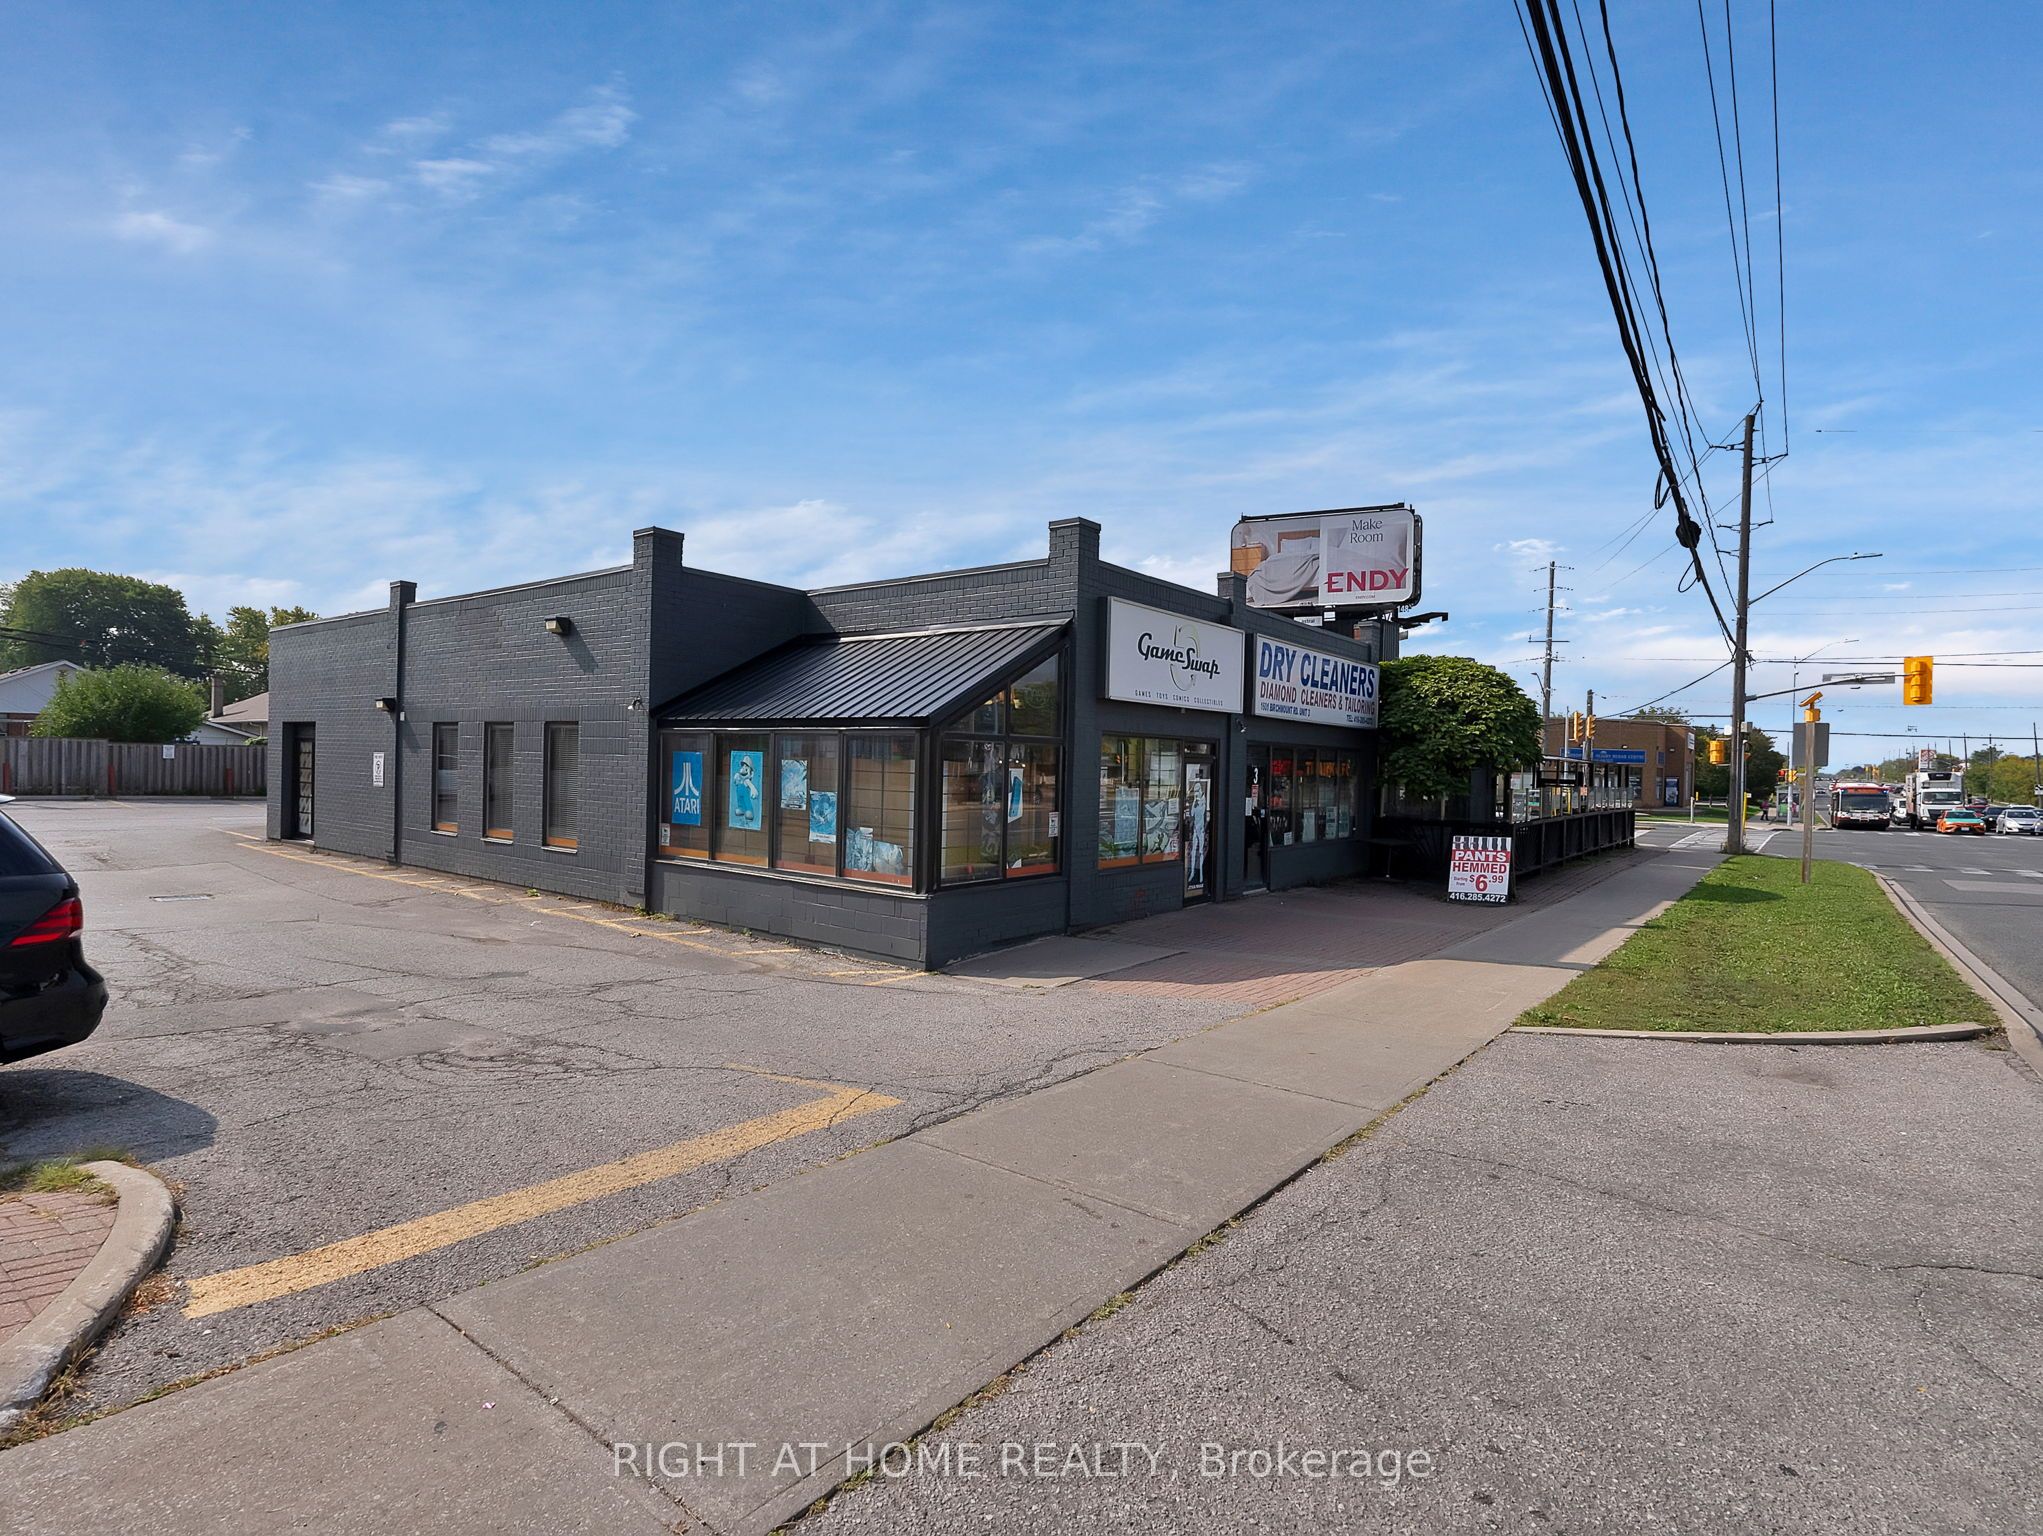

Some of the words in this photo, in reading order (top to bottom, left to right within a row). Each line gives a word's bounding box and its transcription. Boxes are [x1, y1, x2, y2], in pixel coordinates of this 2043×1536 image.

[1352, 518, 1383, 532] Make
[1350, 532, 1384, 544] Room
[1325, 568, 1409, 593] ENDY
[1259, 642, 1297, 682] DRY
[1300, 652, 1376, 698] CLEANERS
[1135, 689, 1151, 698] GAMES
[1156, 692, 1168, 700] TOYS
[1172, 694, 1190, 703] COMICS
[1193, 697, 1224, 707] COLLECTIBLES
[1260, 681, 1297, 704] DIAMOND
[1300, 689, 1337, 710] CLEANERS
[1338, 695, 1343, 710] &
[1344, 696, 1375, 715] TAILORING
[1299, 707, 1308, 717] UNIT
[1253, 767, 1259, 784] 3
[674, 797, 700, 815] ATARI
[1454, 850, 1507, 862] PANTS
[1452, 862, 1507, 874] HEMMED
[1449, 892, 1506, 903] 416.285.4272
